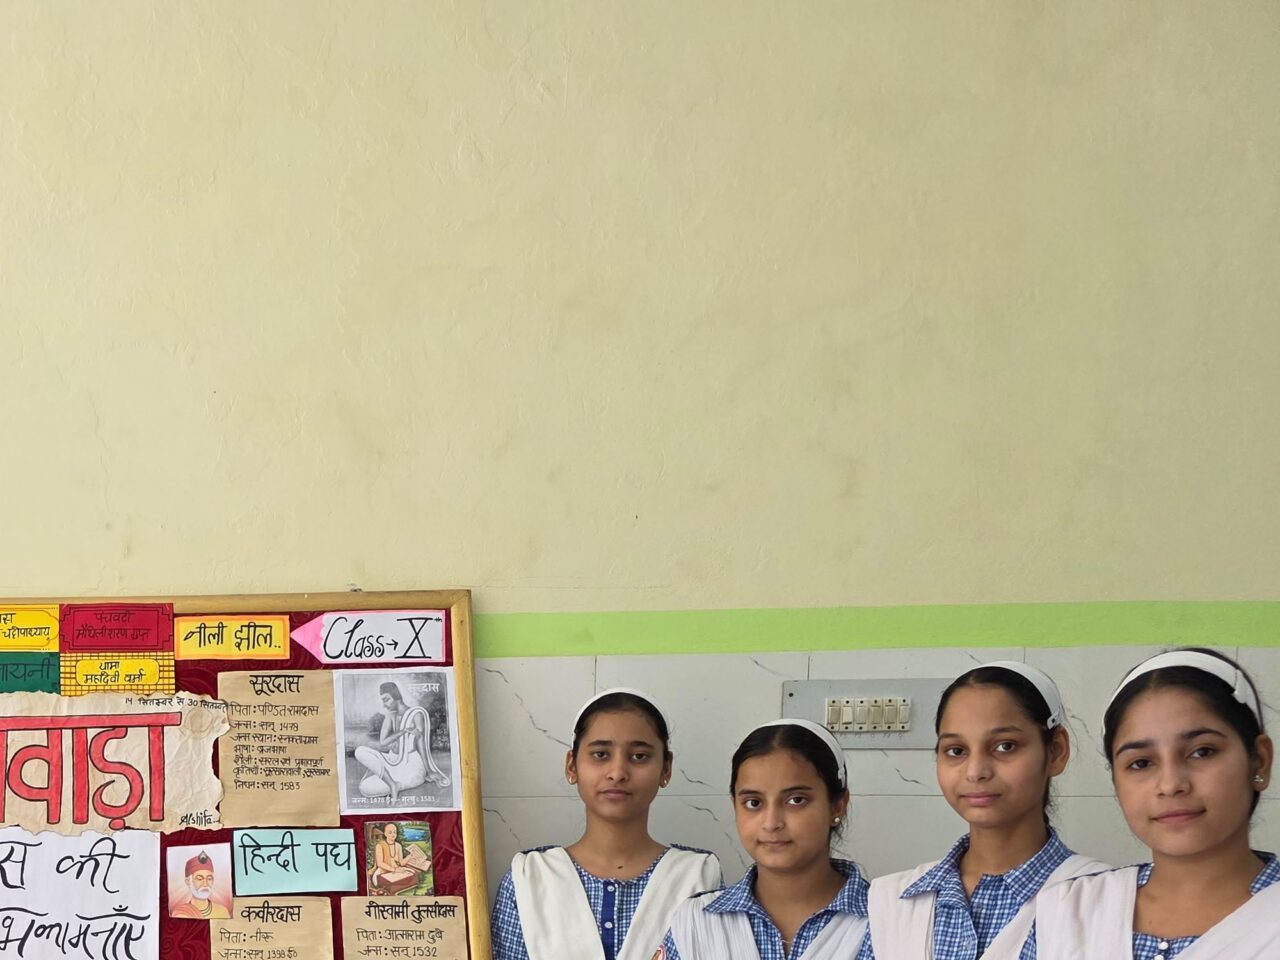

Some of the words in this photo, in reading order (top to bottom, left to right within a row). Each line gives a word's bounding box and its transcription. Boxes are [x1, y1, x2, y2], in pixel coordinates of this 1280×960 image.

[184, 621, 228, 648] नीली
[323, 616, 385, 659] Class
[249, 675, 304, 696] सूरदास
[187, 698, 198, 706] 30
[280, 781, 300, 790] 1583
[56, 837, 131, 893] की
[238, 831, 301, 876] हिन्दी
[411, 901, 458, 924] तुलसीदास
[412, 946, 438, 957] 1532
